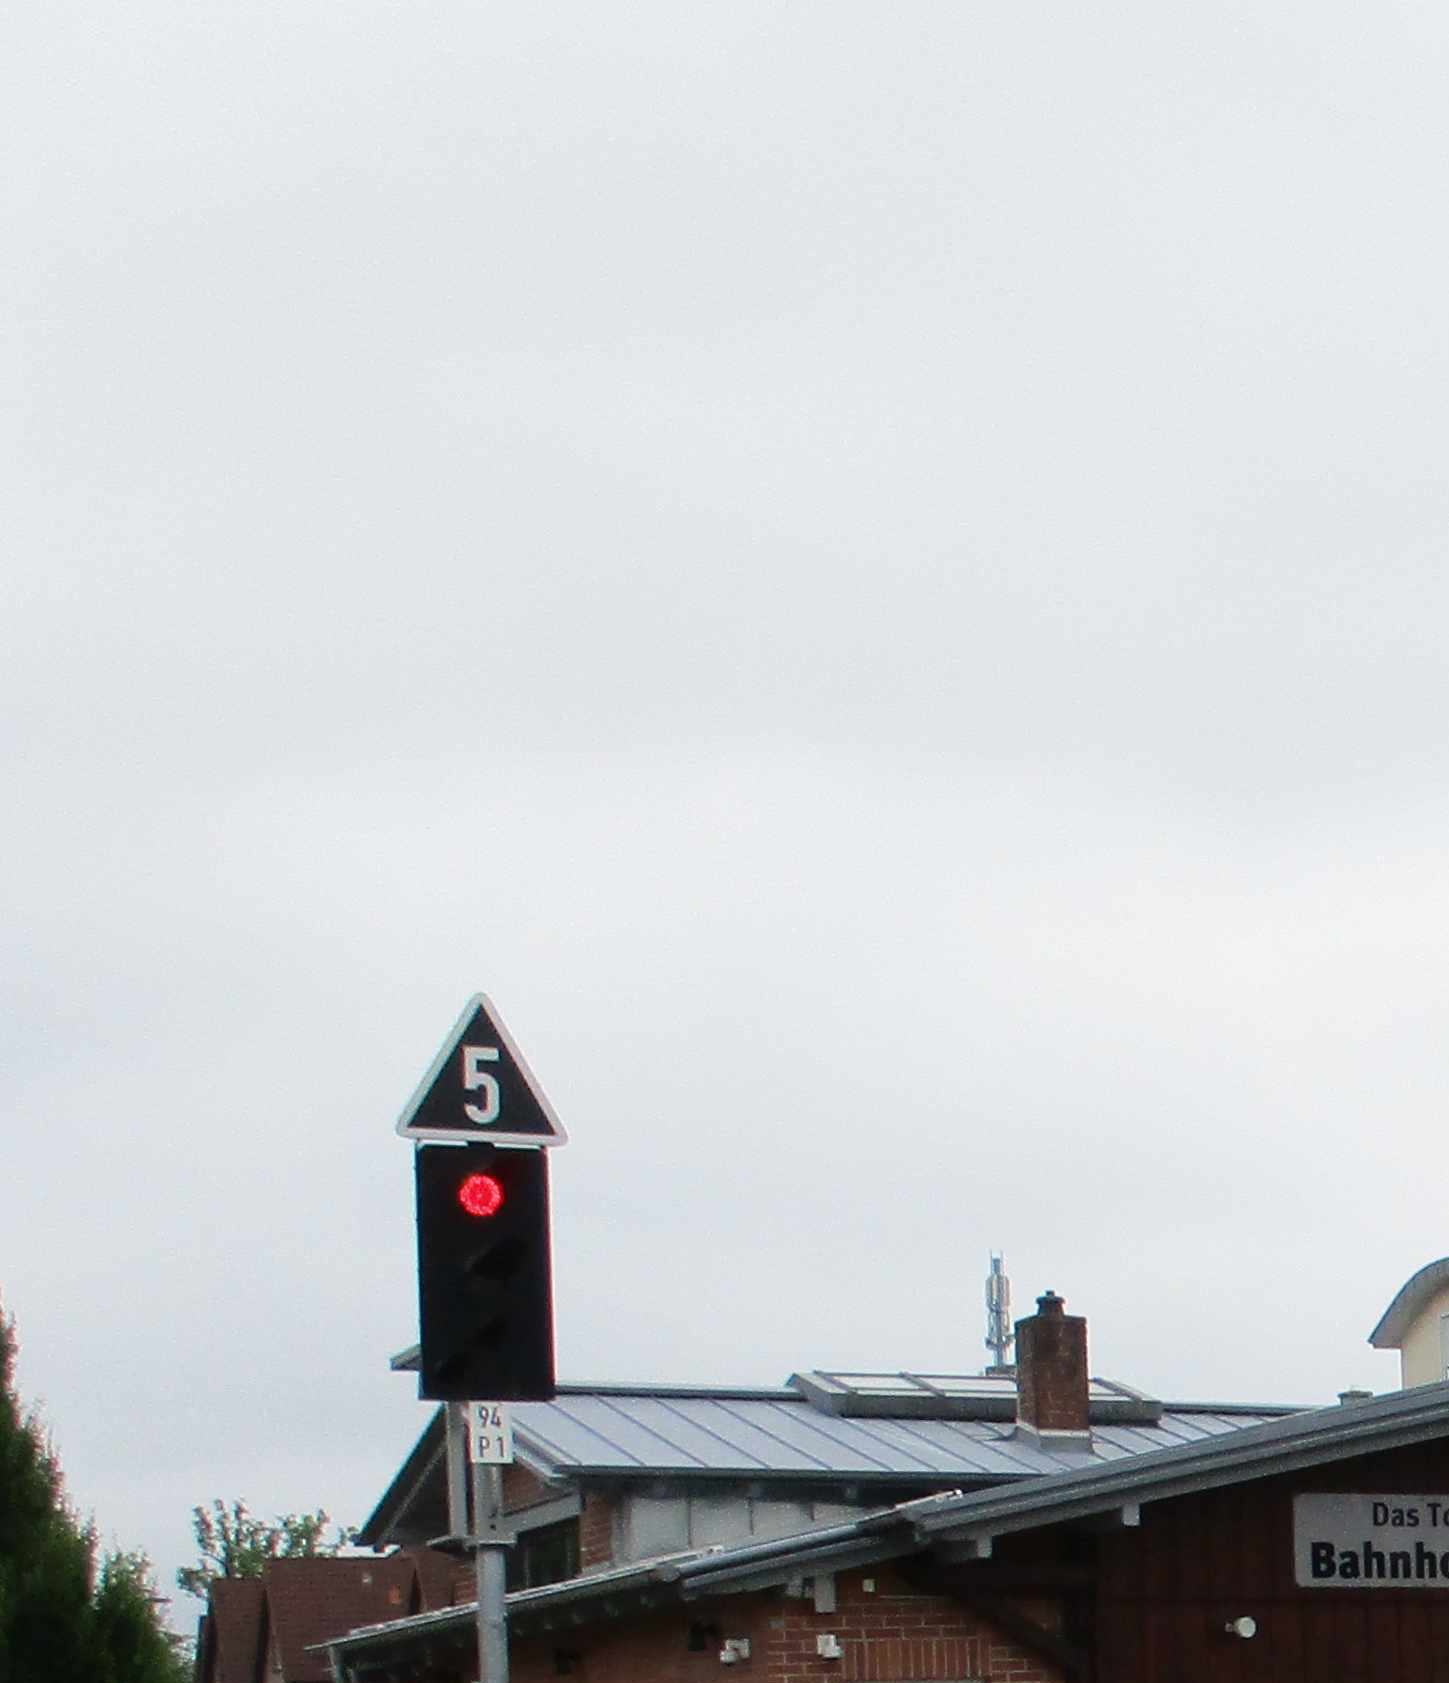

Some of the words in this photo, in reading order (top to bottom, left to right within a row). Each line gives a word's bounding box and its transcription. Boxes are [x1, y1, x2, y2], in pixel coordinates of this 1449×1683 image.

[463, 1046, 499, 1124] 5
[479, 1406, 502, 1427] 94
[1372, 1502, 1420, 1528] Das
